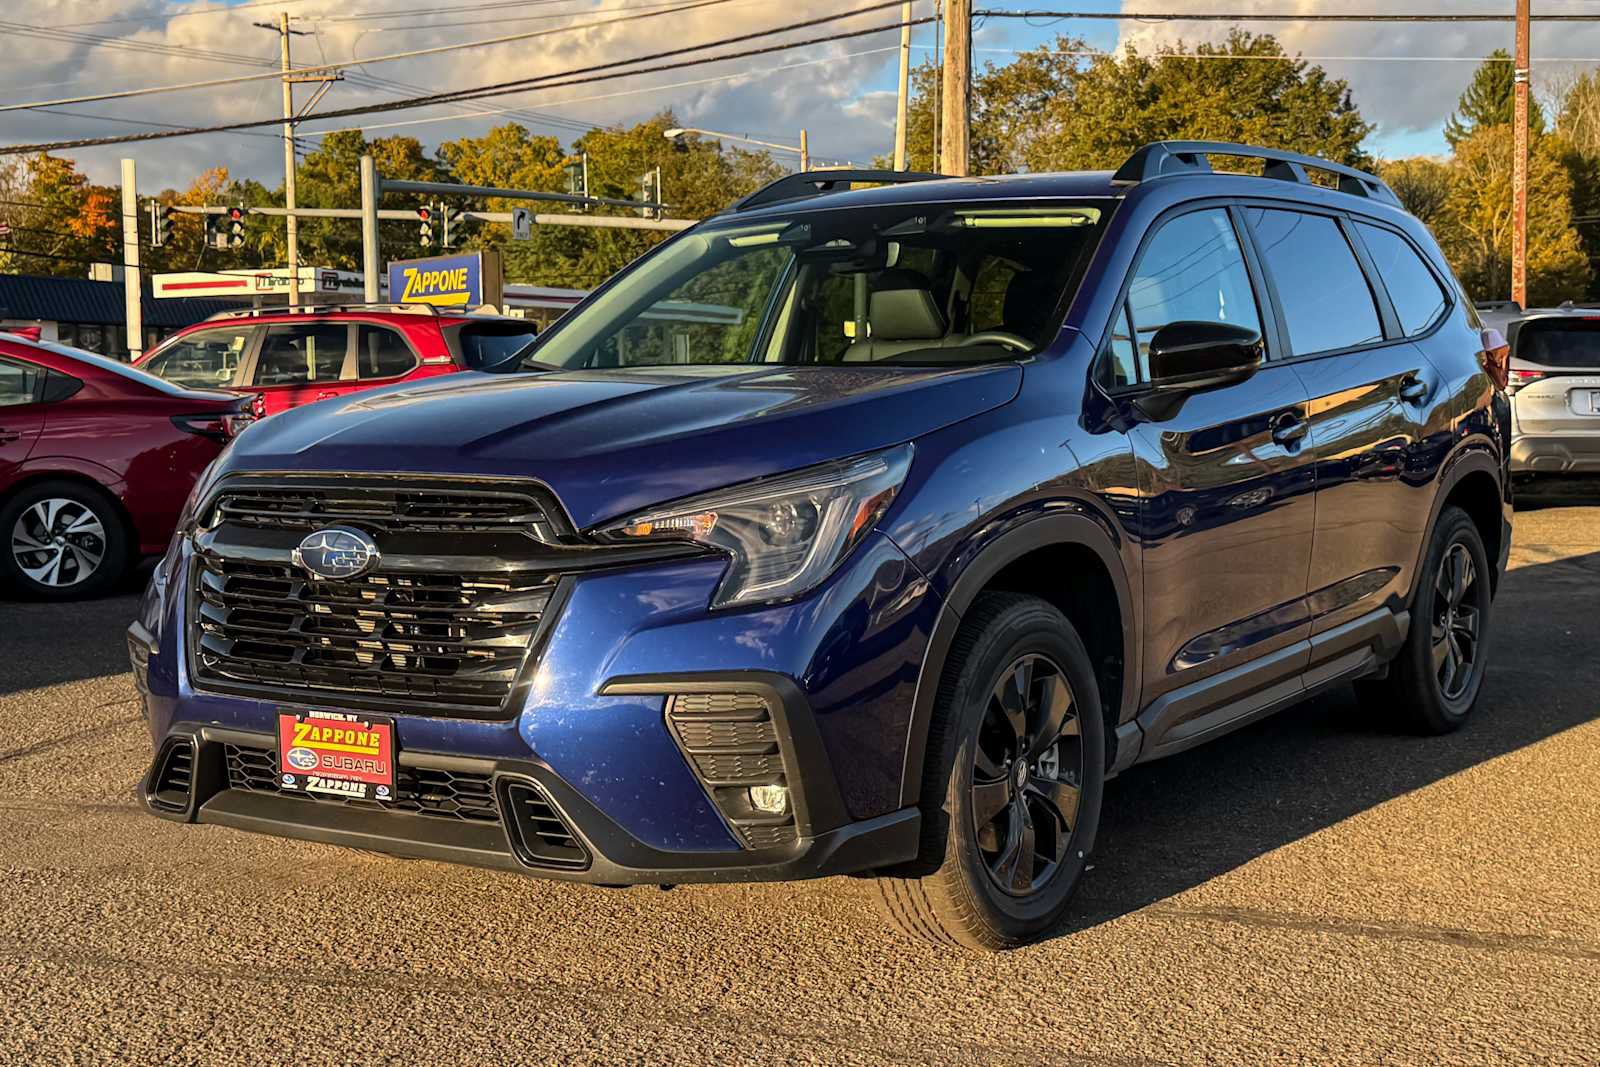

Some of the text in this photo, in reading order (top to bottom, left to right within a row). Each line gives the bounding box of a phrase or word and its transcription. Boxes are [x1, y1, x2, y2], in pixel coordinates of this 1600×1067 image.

[401, 267, 470, 305] ZAPPONE
[291, 722, 381, 755] ZAPPONE
[322, 754, 387, 775] SUBARU
[306, 776, 367, 798] ZAPPONE
